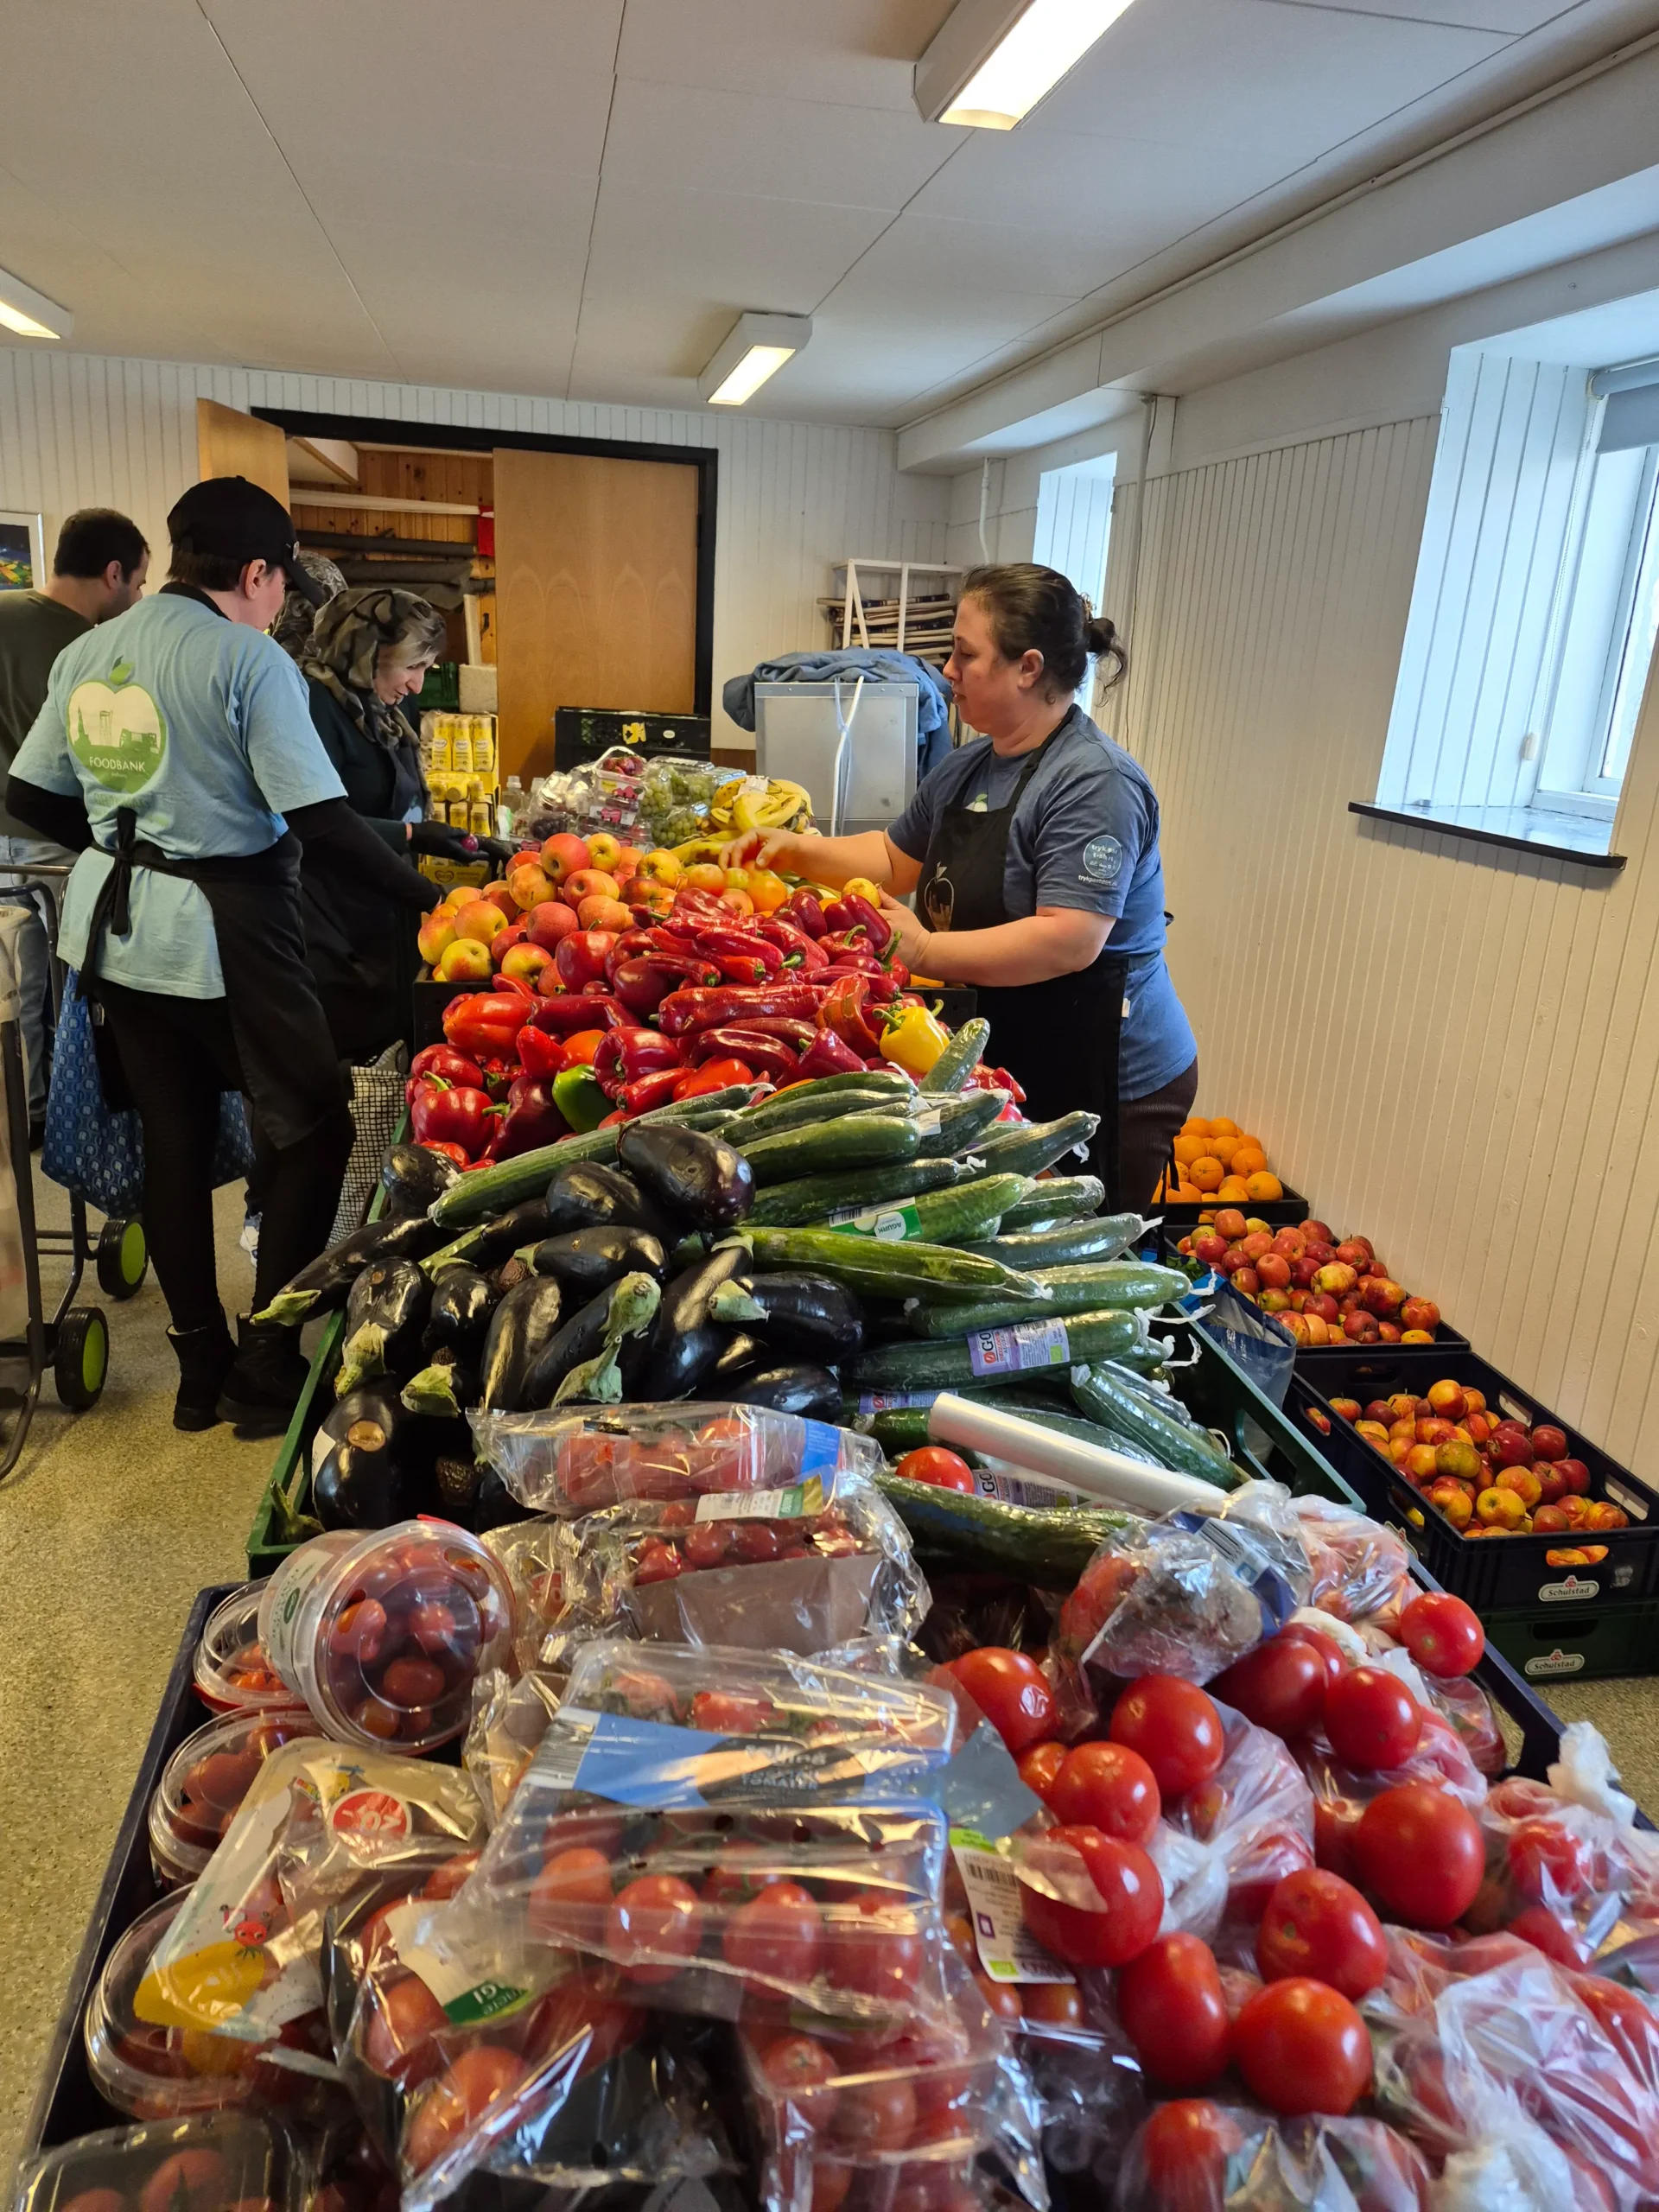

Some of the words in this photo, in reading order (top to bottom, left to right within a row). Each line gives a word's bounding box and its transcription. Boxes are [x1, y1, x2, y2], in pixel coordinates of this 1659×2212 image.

[89, 756, 146, 772] FOODBANK
[878, 1221, 902, 1234] AGURK
[1548, 1586, 1590, 1597] Schulstad
[1534, 1660, 1575, 1670] Schulstad
